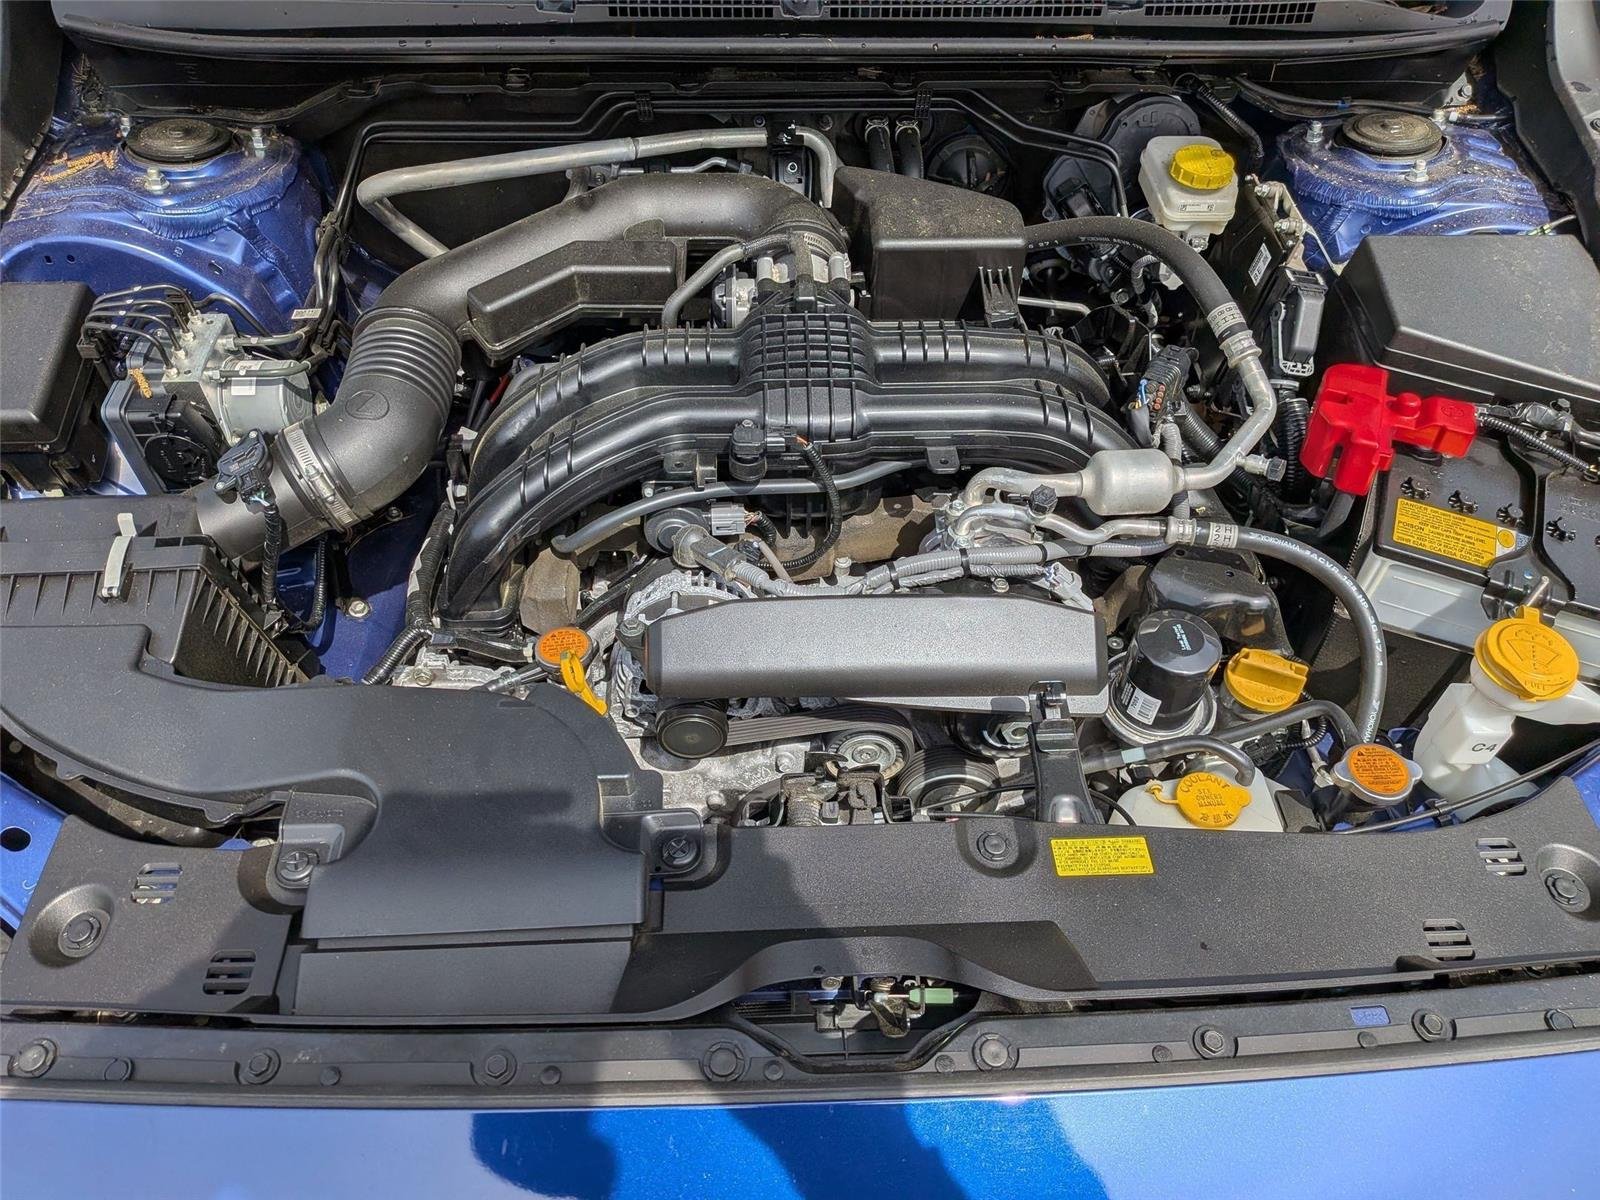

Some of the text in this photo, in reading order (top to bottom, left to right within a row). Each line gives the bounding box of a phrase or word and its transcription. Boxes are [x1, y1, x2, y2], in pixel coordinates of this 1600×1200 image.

[1400, 500, 1428, 511] DANGER
[1398, 520, 1425, 531] POISON
[1259, 532, 1300, 552] YOKOHAMA
[1363, 711, 1378, 743] YOKOHAM
[1471, 743, 1497, 753] C4
[1180, 774, 1231, 793] COOLANT
